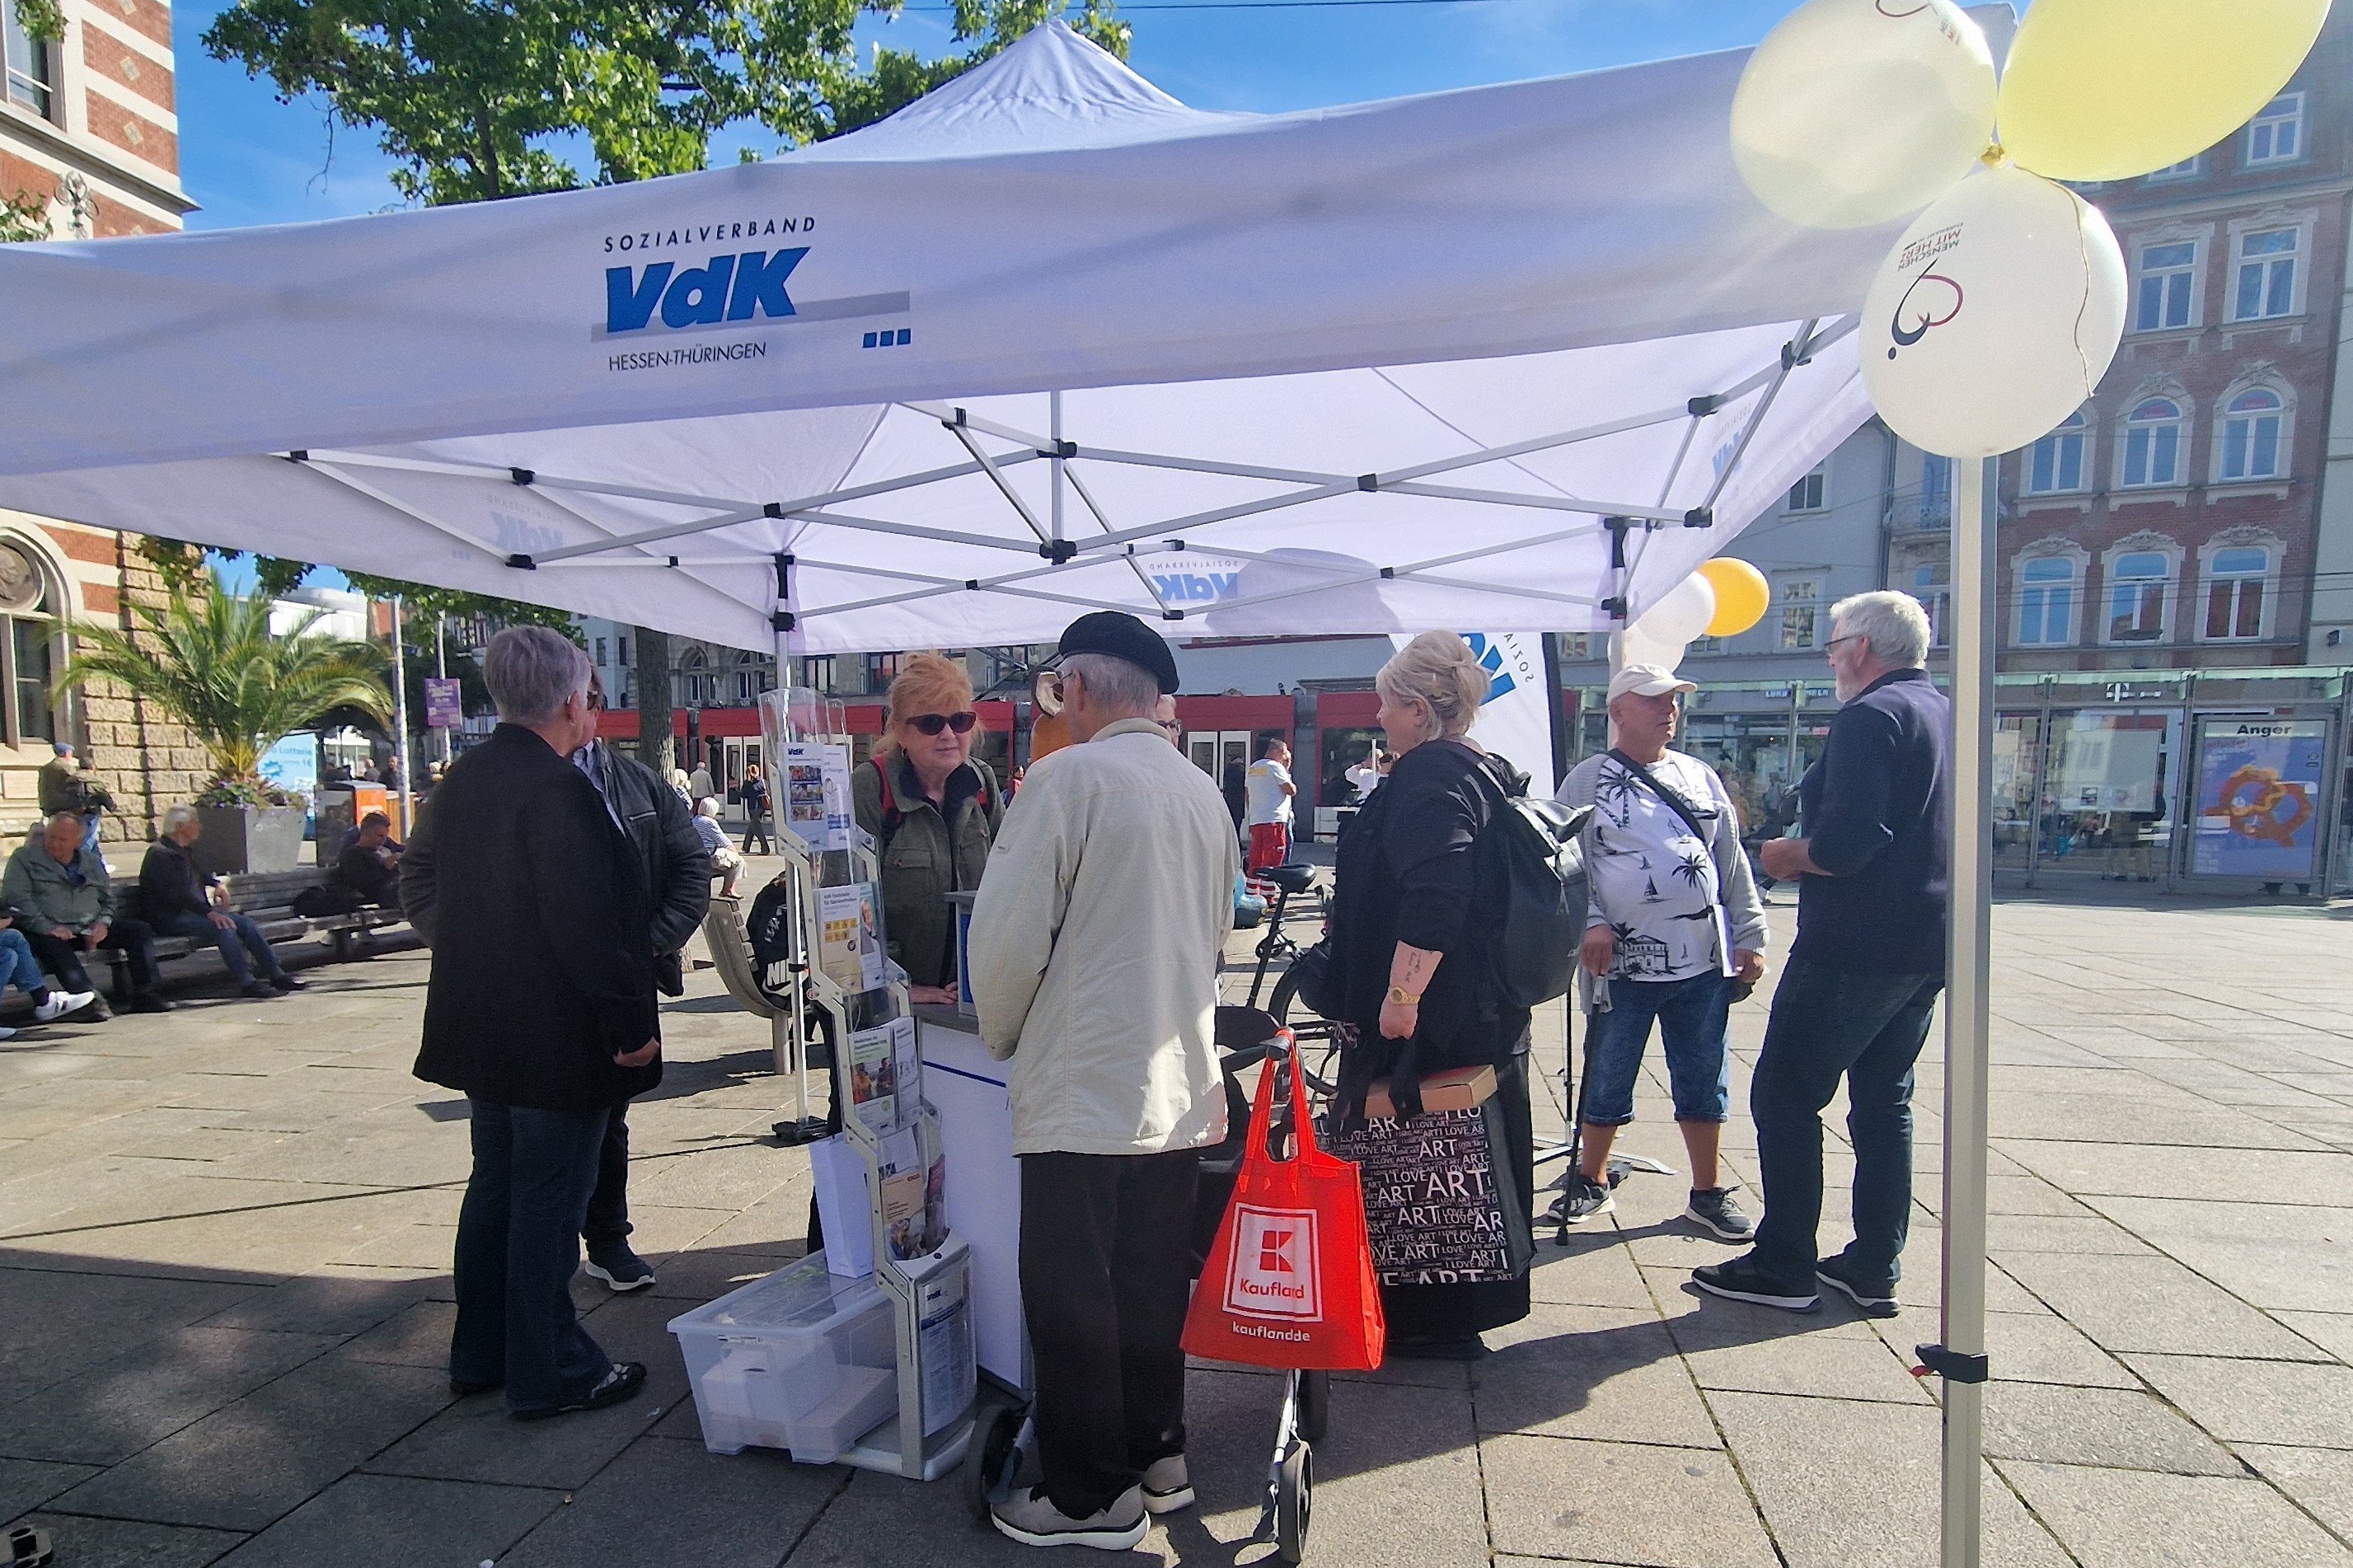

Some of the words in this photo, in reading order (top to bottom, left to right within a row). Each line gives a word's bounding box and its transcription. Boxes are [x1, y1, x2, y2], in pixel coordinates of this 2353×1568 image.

[604, 217, 816, 253] SOZIALVERBAND
[1936, 228, 1962, 246] MIT
[1897, 239, 1960, 272] MENSCHEN
[606, 246, 811, 333] VdK
[608, 341, 767, 372] HESSEN-THÜRINGEN
[2237, 724, 2292, 737] Anger
[1445, 1126, 1468, 1135] LOVE
[1419, 1139, 1457, 1158] ART
[1463, 1153, 1486, 1163] ART
[1394, 1170, 1428, 1183] LOVE
[1426, 1168, 1488, 1199] ART
[1379, 1185, 1415, 1203] ART
[1398, 1205, 1438, 1225] ART
[1418, 1232, 1436, 1240] ART
[1454, 1233, 1485, 1243] LOVE
[1404, 1243, 1439, 1259] ART
[1471, 1249, 1498, 1261] ART
